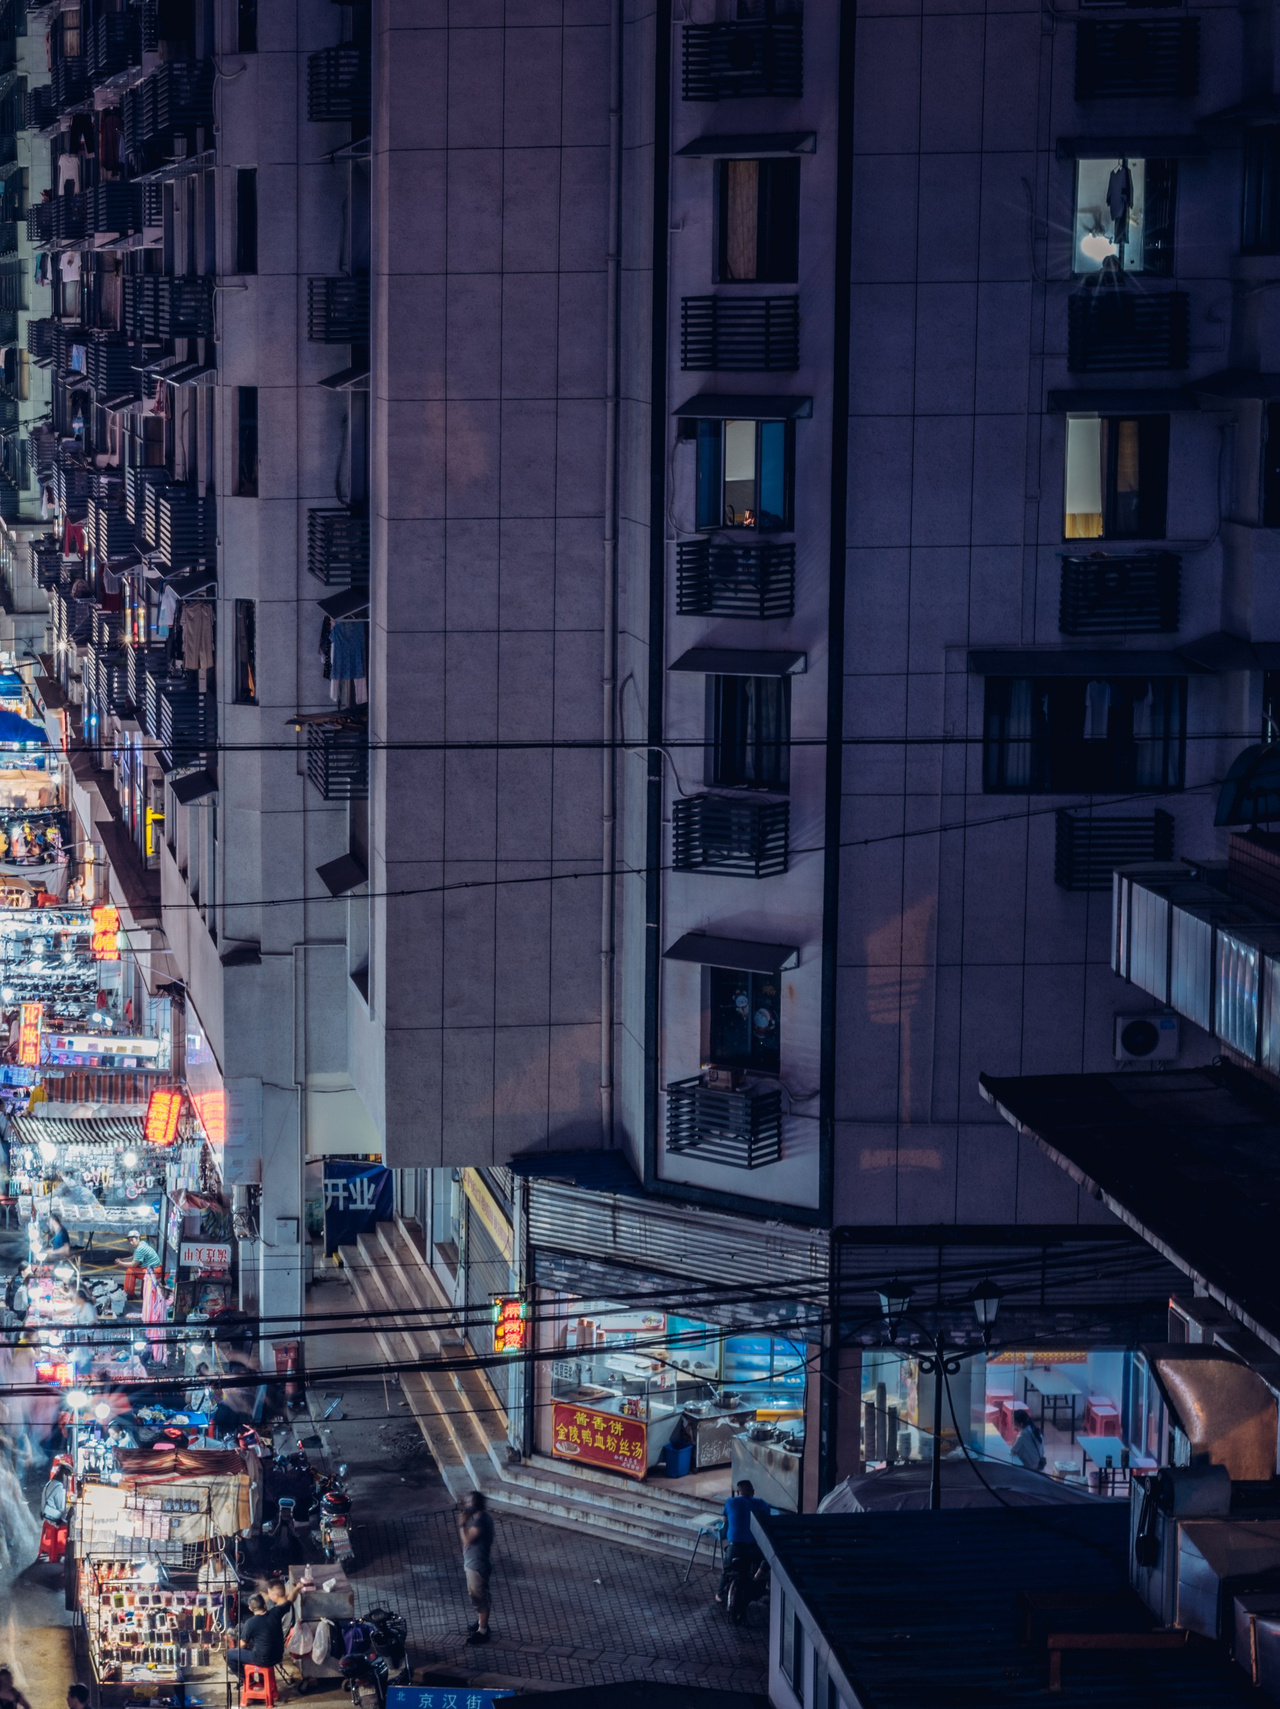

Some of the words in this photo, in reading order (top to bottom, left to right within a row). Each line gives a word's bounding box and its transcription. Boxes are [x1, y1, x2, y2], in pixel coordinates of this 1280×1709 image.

[24, 1006, 38, 1064] 化妆品
[324, 1177, 376, 1211] 开业
[574, 1411, 624, 1436] 酱香饼
[556, 1423, 643, 1460] 金陵鸭血粉丝汤
[419, 1693, 482, 1709] 京汉街
